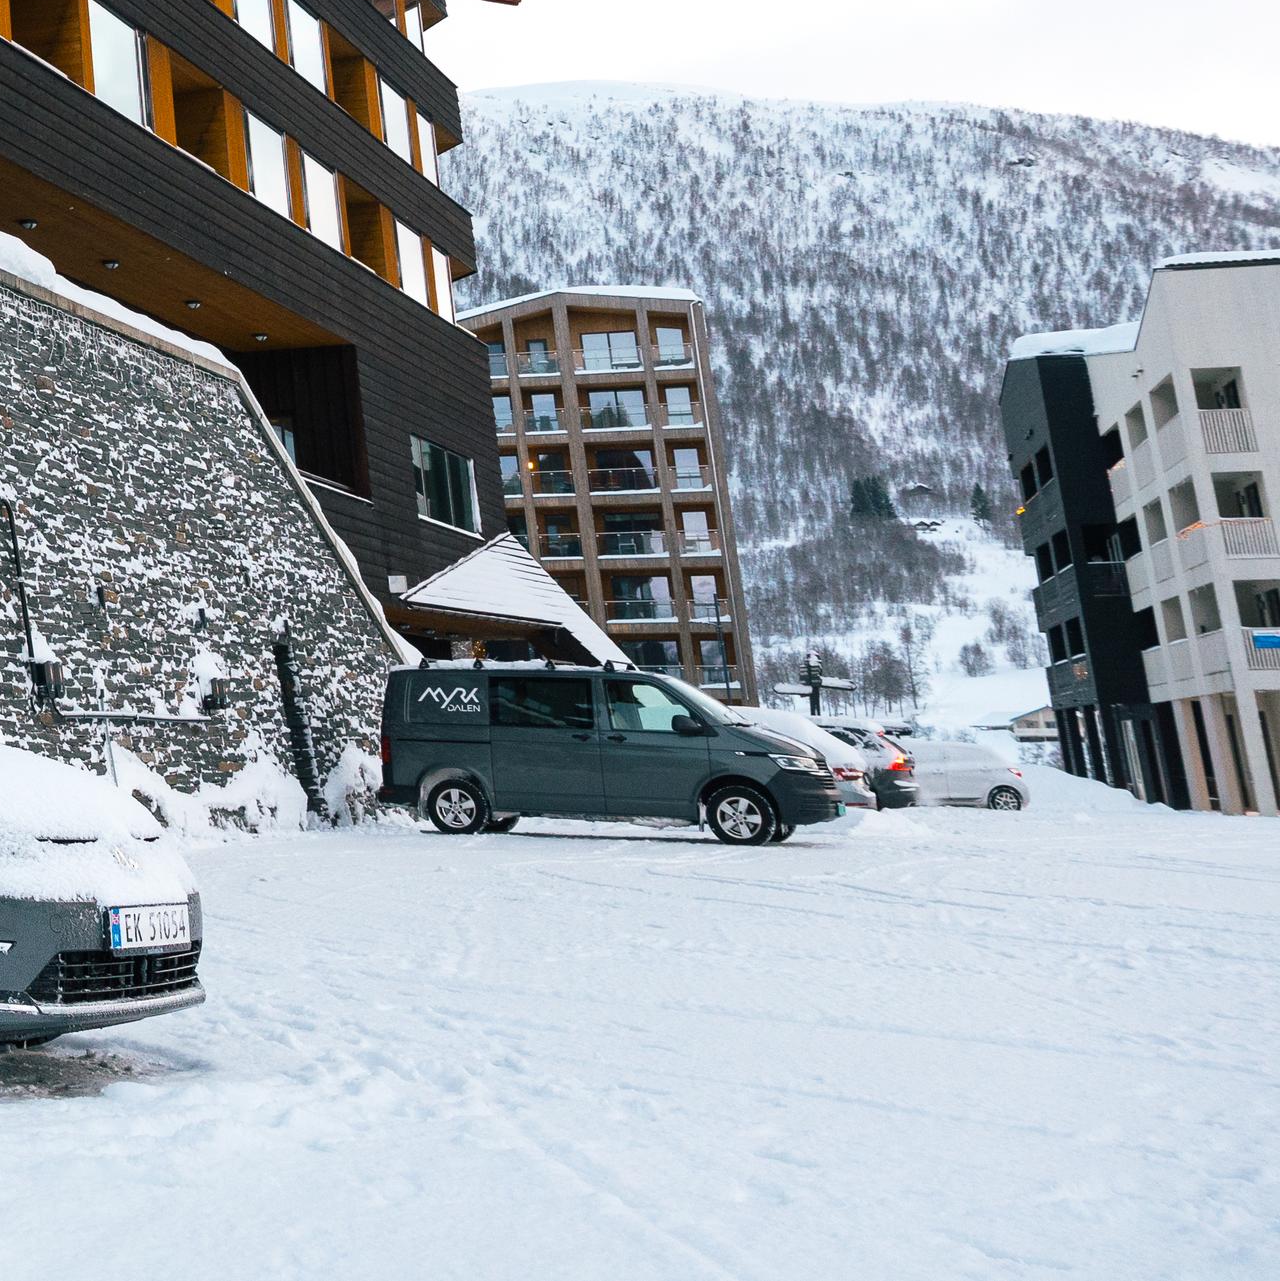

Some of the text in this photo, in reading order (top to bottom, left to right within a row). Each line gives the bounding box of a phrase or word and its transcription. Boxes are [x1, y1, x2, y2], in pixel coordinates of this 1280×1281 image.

[418, 687, 479, 708] MYRK
[447, 704, 480, 712] DALEN
[125, 913, 142, 942] EK
